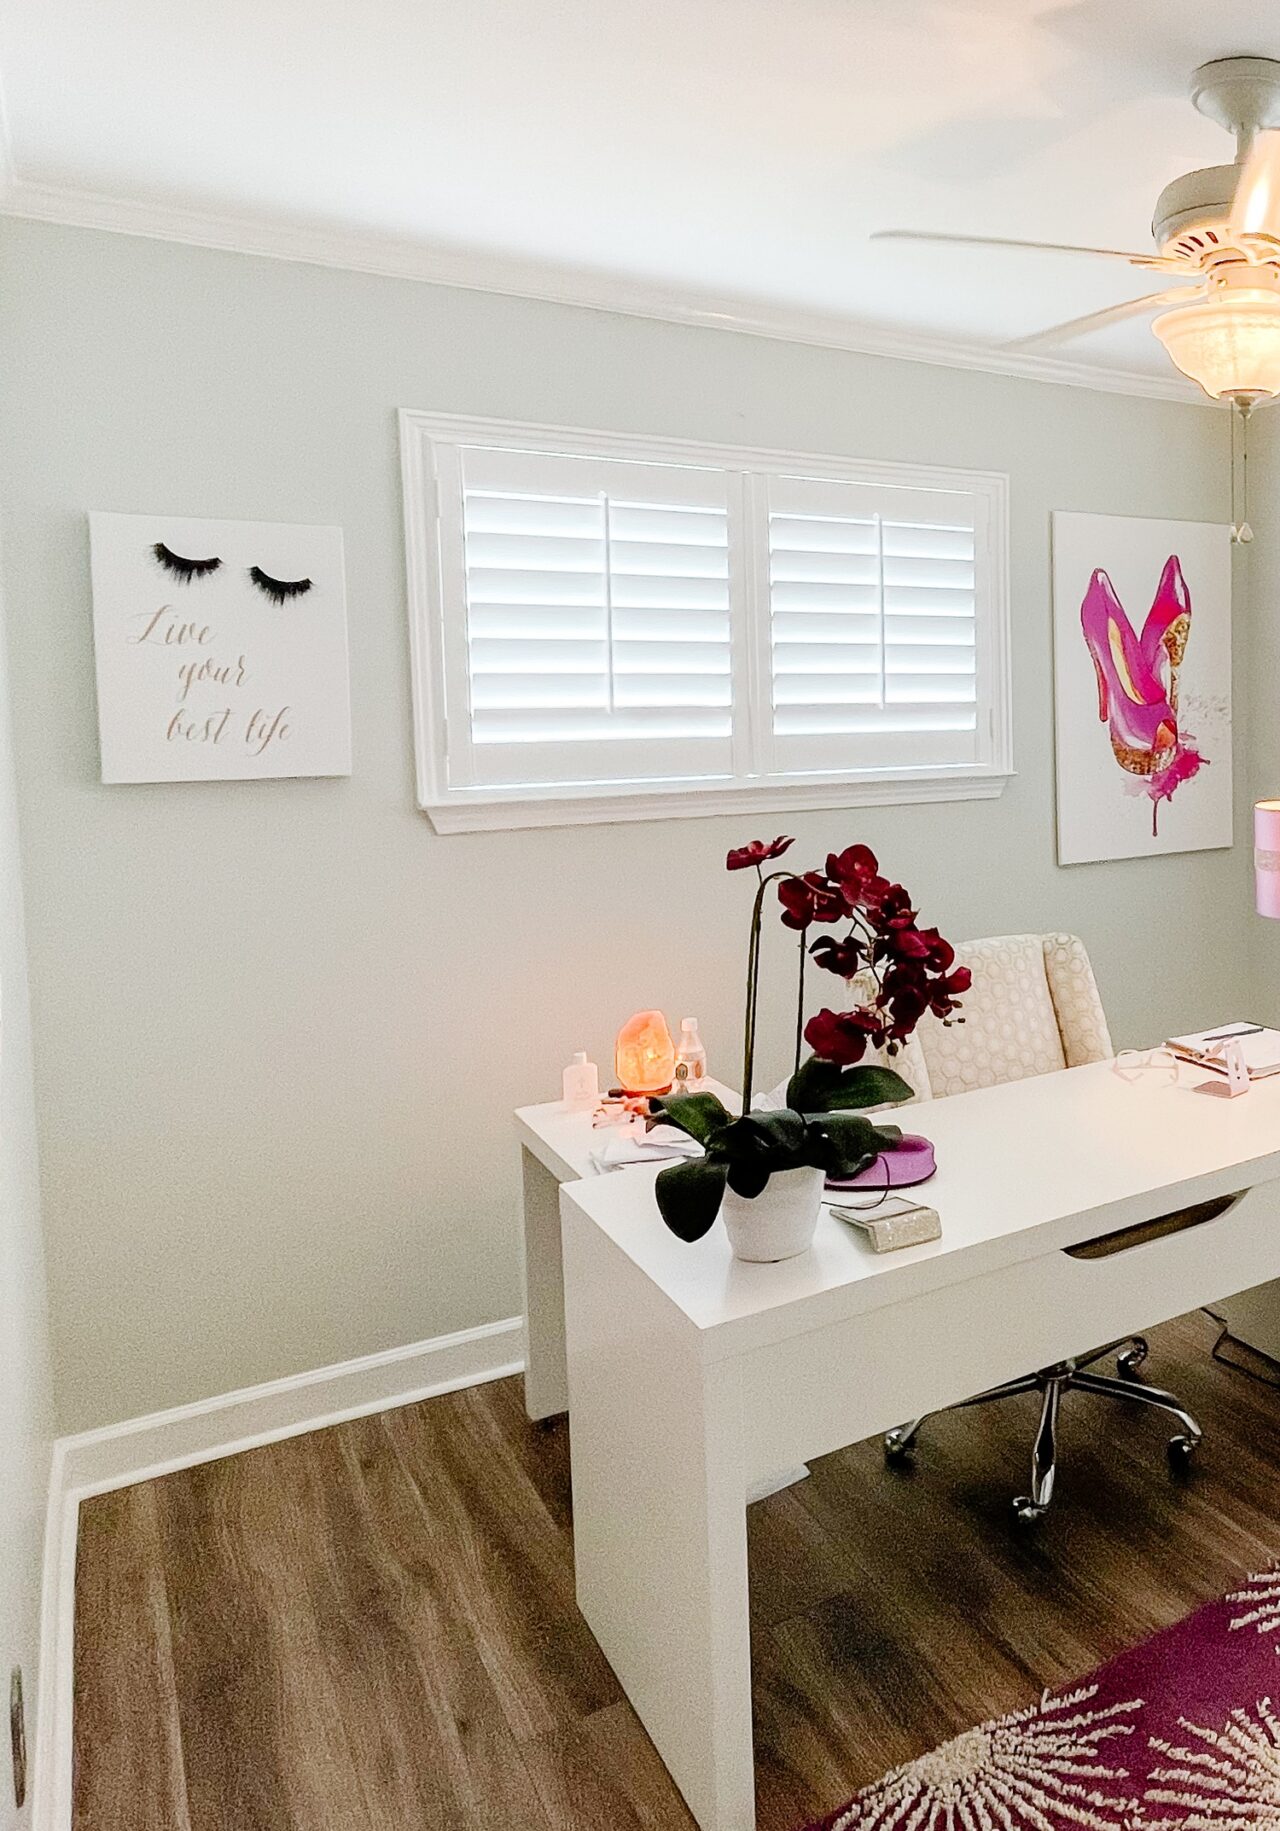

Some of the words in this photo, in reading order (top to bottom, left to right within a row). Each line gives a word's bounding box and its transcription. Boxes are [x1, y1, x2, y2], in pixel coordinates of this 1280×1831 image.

[127, 604, 216, 646] Live
[175, 655, 251, 701] your
[166, 708, 234, 744] best
[244, 706, 293, 756] life
